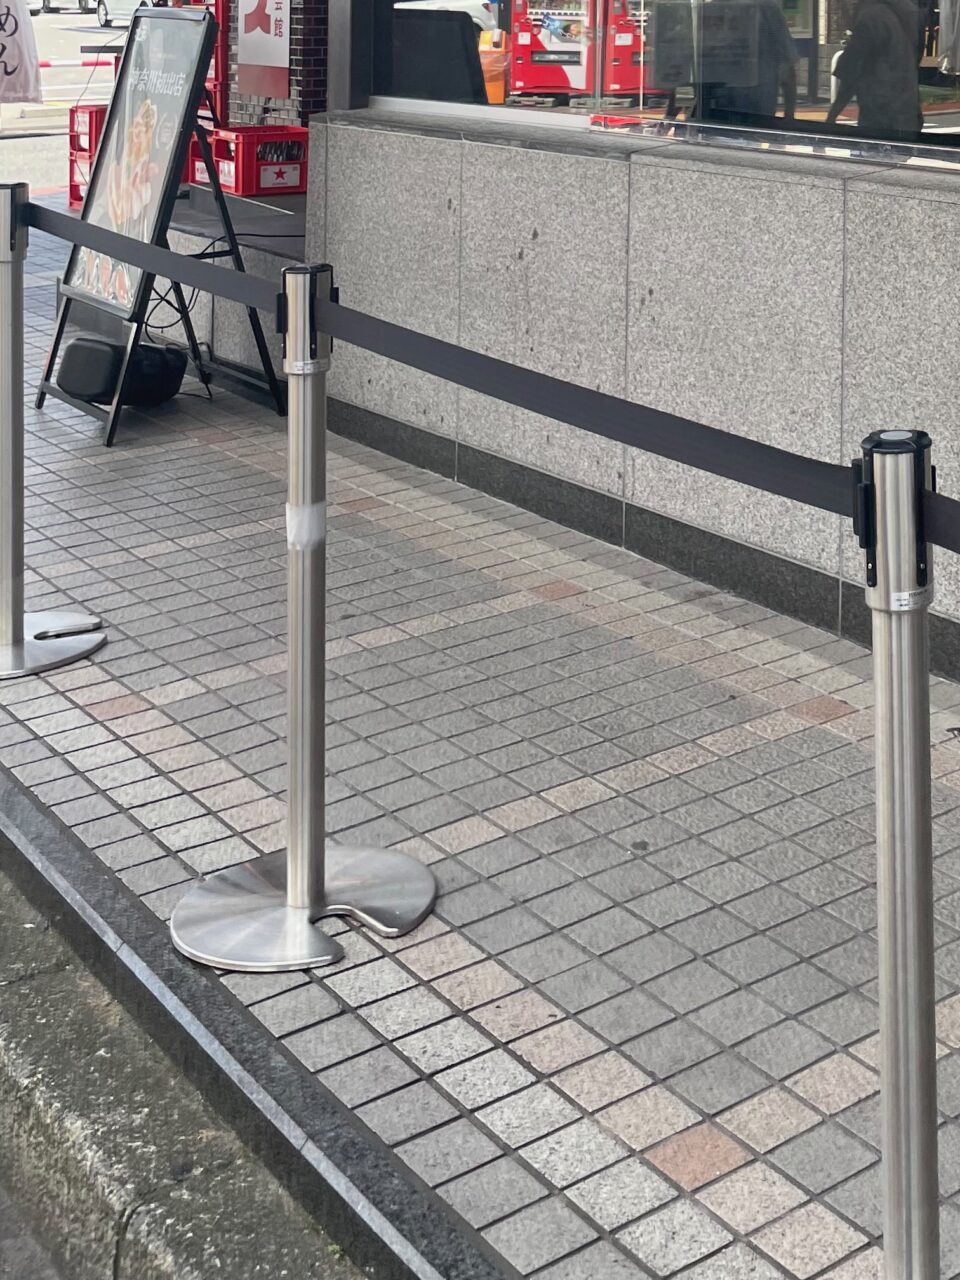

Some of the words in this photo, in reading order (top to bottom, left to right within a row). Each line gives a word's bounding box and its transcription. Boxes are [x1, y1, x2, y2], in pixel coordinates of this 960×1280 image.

[129, 67, 187, 97] 神奈川初出店
